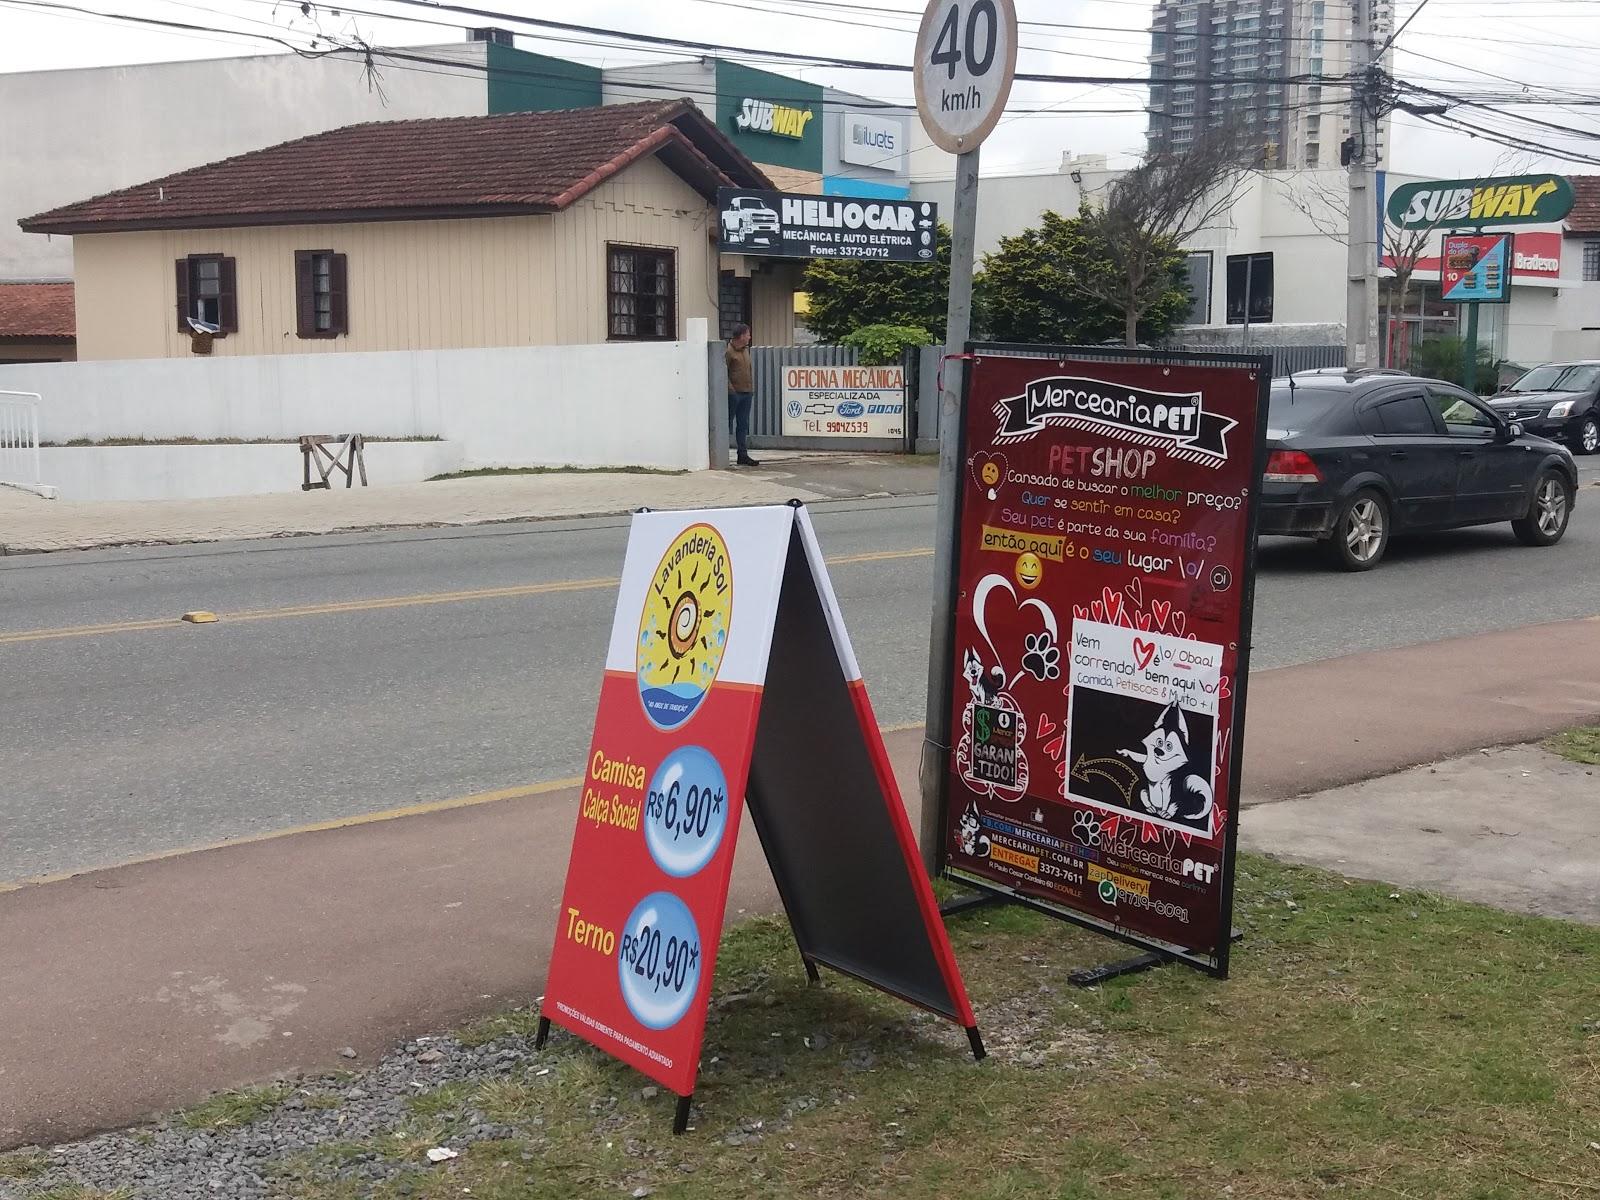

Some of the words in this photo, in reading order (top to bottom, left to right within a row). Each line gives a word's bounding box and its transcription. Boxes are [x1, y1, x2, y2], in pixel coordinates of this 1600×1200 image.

[931, 1, 997, 80] 40
[942, 86, 981, 112] km/h
[737, 97, 813, 139] SUBWAY
[1400, 180, 1557, 222] SUBWAY
[782, 199, 916, 231] HELIOCAR
[783, 230, 832, 243] MECÂNICA
[835, 234, 840, 242] E
[843, 234, 867, 243] AUTO
[810, 245, 837, 256] Fone:
[840, 247, 889, 257] 3373-0712
[1514, 253, 1558, 271] Bradesco
[1447, 273, 1458, 281] 10
[788, 370, 837, 388] OFICINA
[842, 368, 901, 388] MECÂNICA
[809, 391, 880, 400] ESPECIALIZADA
[839, 403, 863, 416] Ford
[868, 405, 903, 414] FIAT
[803, 420, 821, 432] Tel.
[827, 421, 868, 433] 99042539
[1008, 469, 1058, 488] Cansado
[1062, 478, 1075, 490] de
[1078, 480, 1117, 494] buscar
[1121, 487, 1128, 496] o
[1131, 484, 1182, 501] melhor
[1187, 491, 1241, 511] preço?
[1022, 491, 1050, 506] Quer
[1054, 498, 1067, 509] se
[1070, 500, 1110, 514] sentir
[1115, 505, 1133, 518] em
[1137, 508, 1180, 525] casa?
[1001, 508, 1027, 525] Seu
[1031, 512, 1054, 529] pet
[1057, 518, 1064, 530] é
[1067, 521, 1101, 537] parte
[1105, 525, 1119, 538] da
[1123, 530, 1146, 542] sua
[1151, 529, 1216, 552] família?
[984, 531, 1025, 550] então
[1030, 539, 1063, 557] aqui
[1066, 542, 1075, 557] é
[1080, 547, 1089, 560] o
[1093, 550, 1121, 564] seu
[1127, 549, 1173, 574] lugar
[654, 533, 717, 595] Lavanderia
[713, 557, 728, 597] Sol
[1213, 571, 1226, 584] oi
[1076, 632, 1100, 650] Vem
[1075, 655, 1136, 676] correndo!
[1154, 655, 1160, 666] é
[1179, 651, 1214, 667] Obaa!
[1145, 669, 1169, 685] bem
[1172, 679, 1196, 693] aqui
[1077, 673, 1113, 688] Comida,
[1116, 677, 1159, 696] Petiscos
[1161, 688, 1166, 698] &
[1169, 689, 1197, 706] Muito
[974, 743, 1014, 764] GARAN
[591, 750, 646, 790] Camisa
[583, 787, 611, 829] Calça
[611, 794, 642, 832] Social
[992, 833, 1084, 870] MERCEARIAPET.COM.BR
[992, 847, 1036, 868] ENTREGAS
[1040, 862, 1083, 885] 3373-7611
[1140, 868, 1164, 881] merece
[1054, 881, 1082, 898] ECOVILLE
[1118, 887, 1190, 924] 9719-6091
[567, 908, 615, 956] Terno
[594, 1020, 613, 1037] SOMENTE
[613, 1030, 624, 1042] PARA
[623, 1035, 648, 1056] PAGAMENTO
